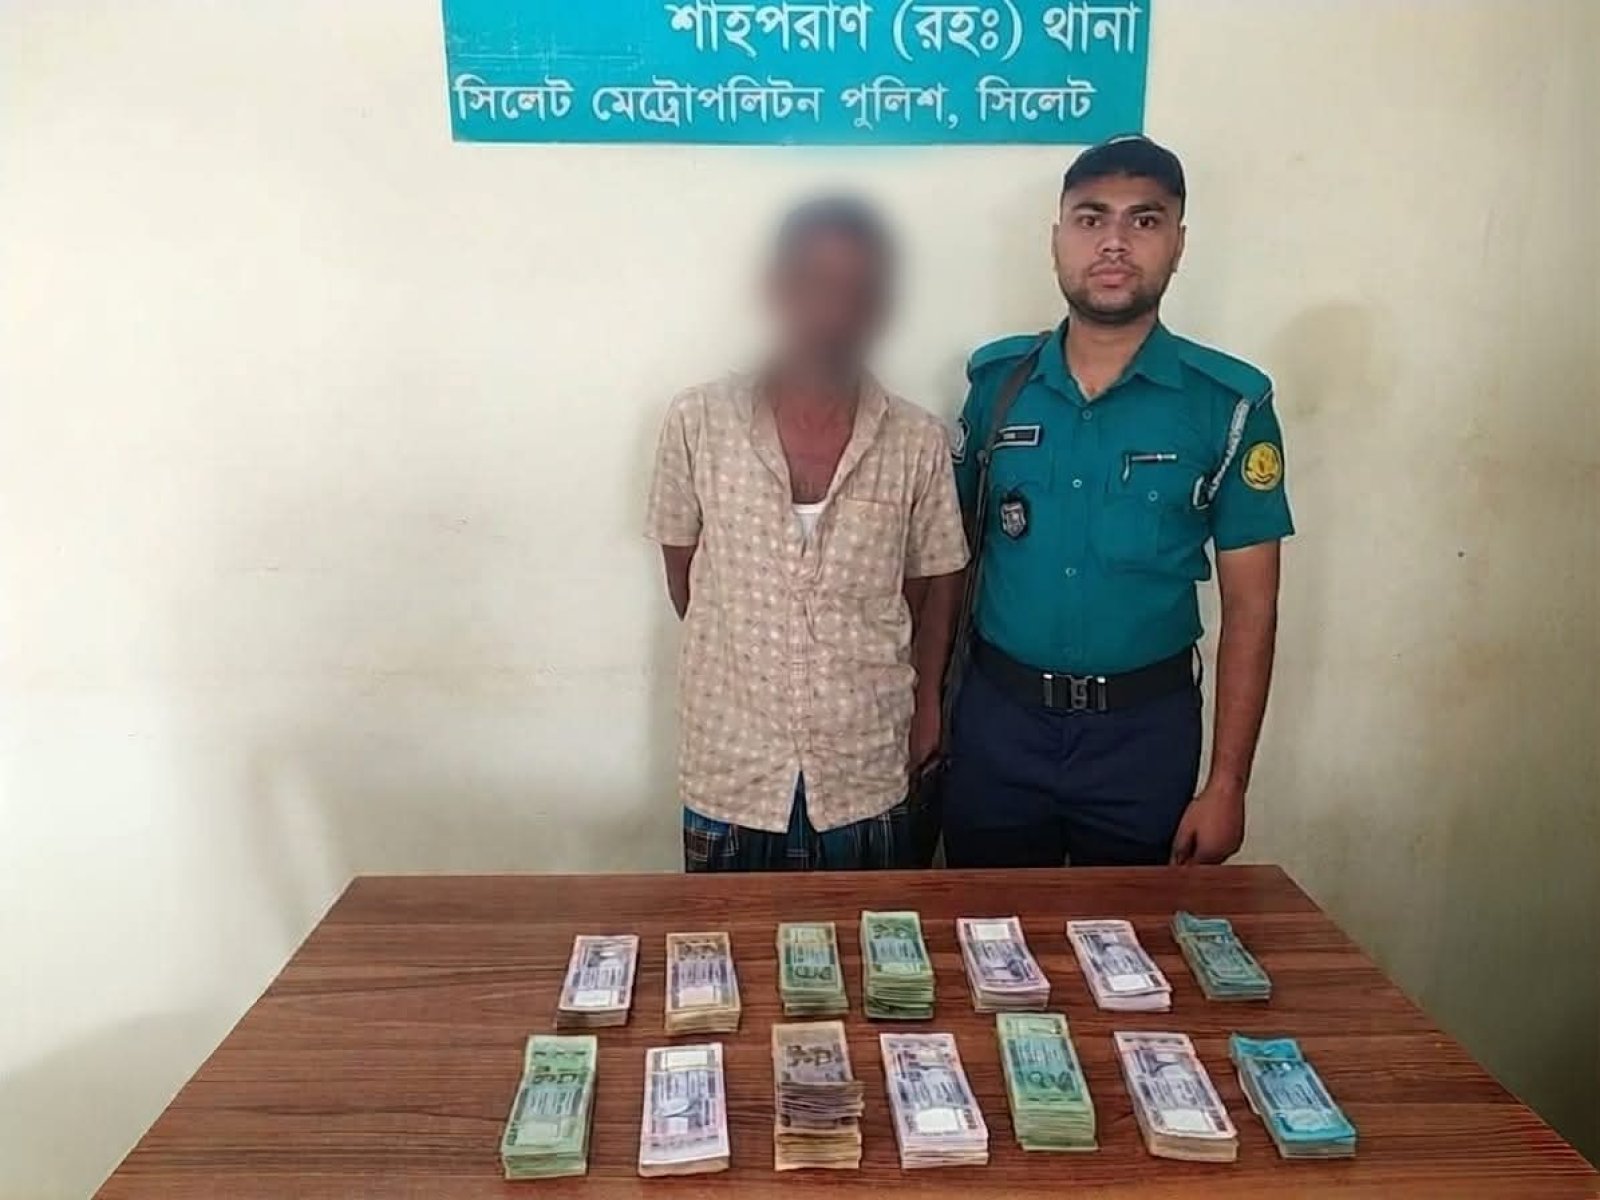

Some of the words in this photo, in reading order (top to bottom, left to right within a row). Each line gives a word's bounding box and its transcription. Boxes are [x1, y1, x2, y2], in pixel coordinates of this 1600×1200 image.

[664, 0, 873, 58] শাহপরাণ
[893, 0, 1022, 61] (রহঃ)
[1042, 1, 1142, 54] থানা
[452, 74, 574, 121] সিলেট
[592, 75, 825, 127] মেট্রোপলিটন
[840, 74, 959, 129] পুলিশ,
[975, 74, 1097, 121] সিলেট
